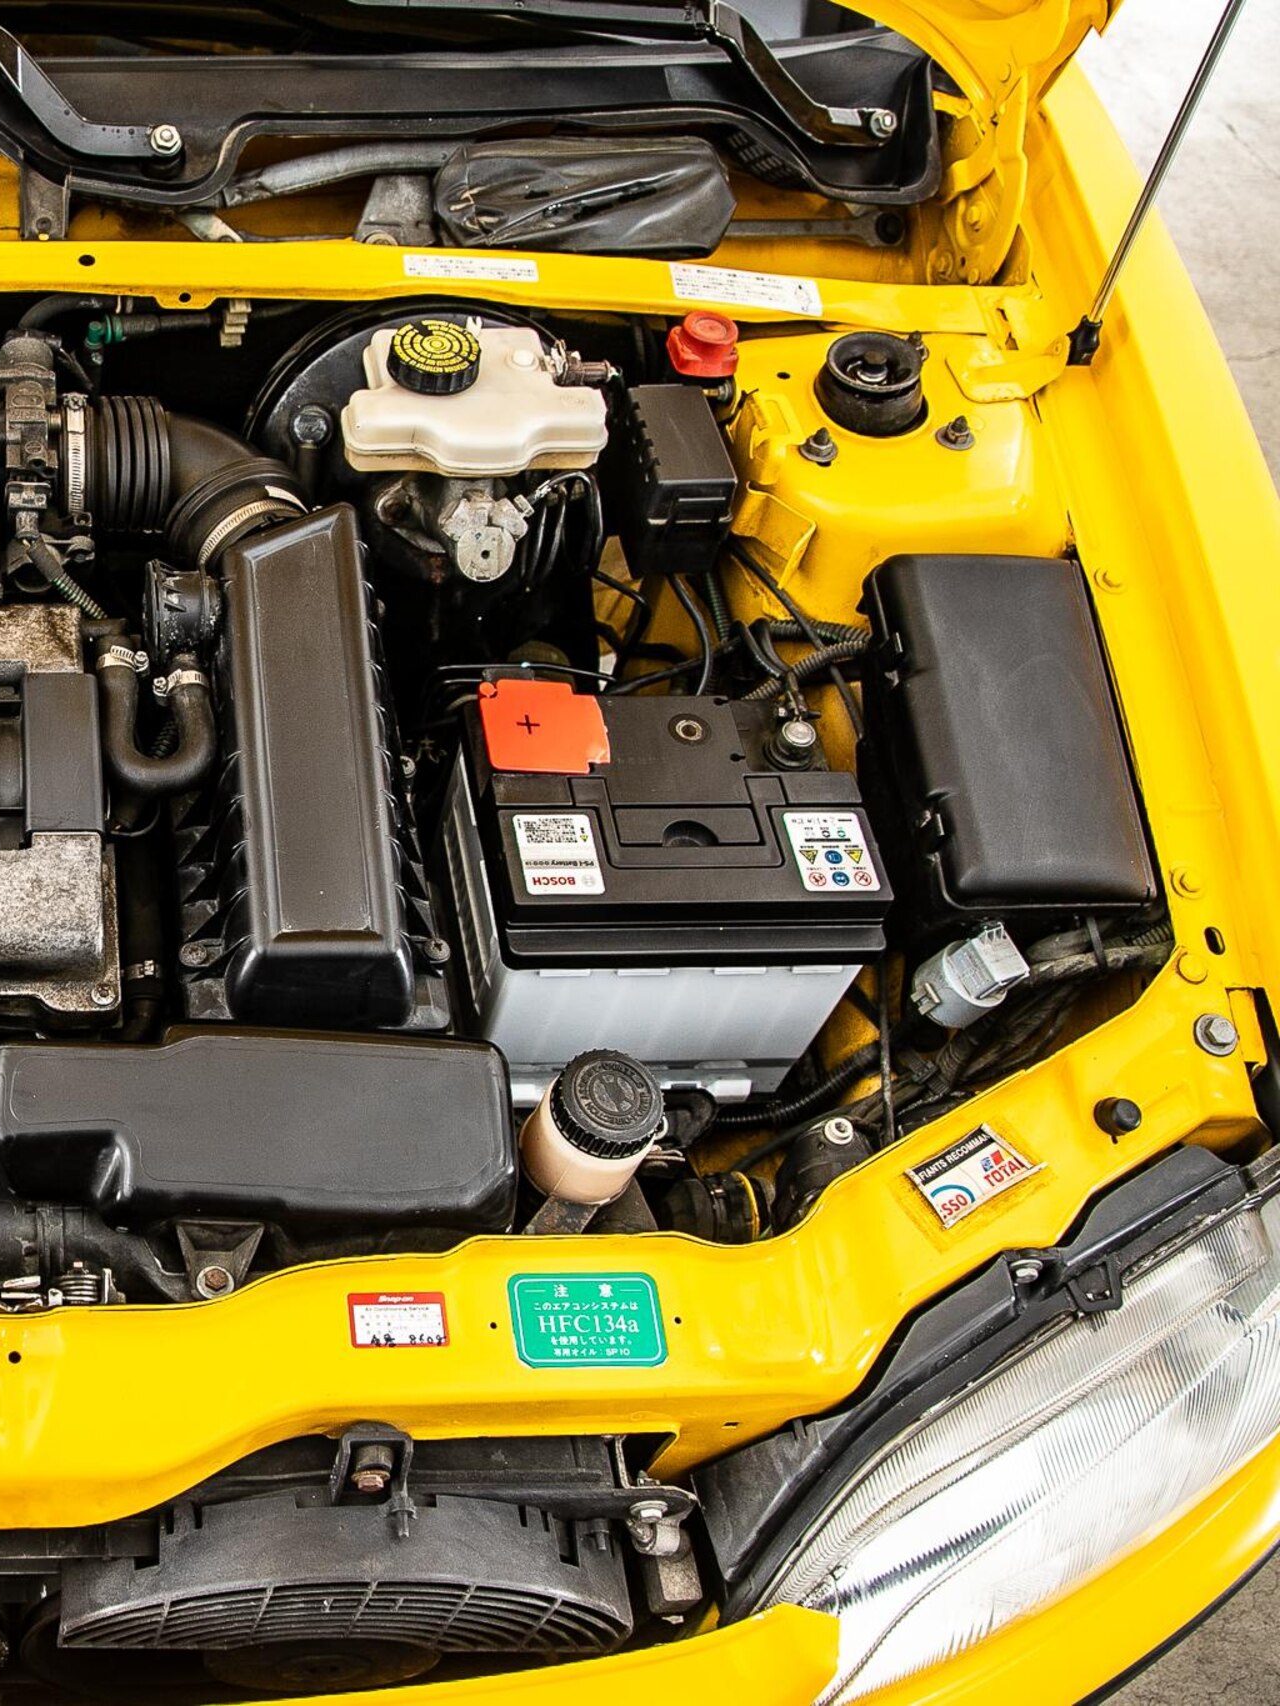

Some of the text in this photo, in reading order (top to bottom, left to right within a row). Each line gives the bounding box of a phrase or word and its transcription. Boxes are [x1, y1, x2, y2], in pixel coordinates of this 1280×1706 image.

[532, 876, 576, 886] BOSCH
[940, 1193, 969, 1219] SSO
[533, 1301, 639, 1311] このエアコンシステムは
[538, 1314, 640, 1333] HFC134a
[550, 1335, 633, 1346] を使用しています。
